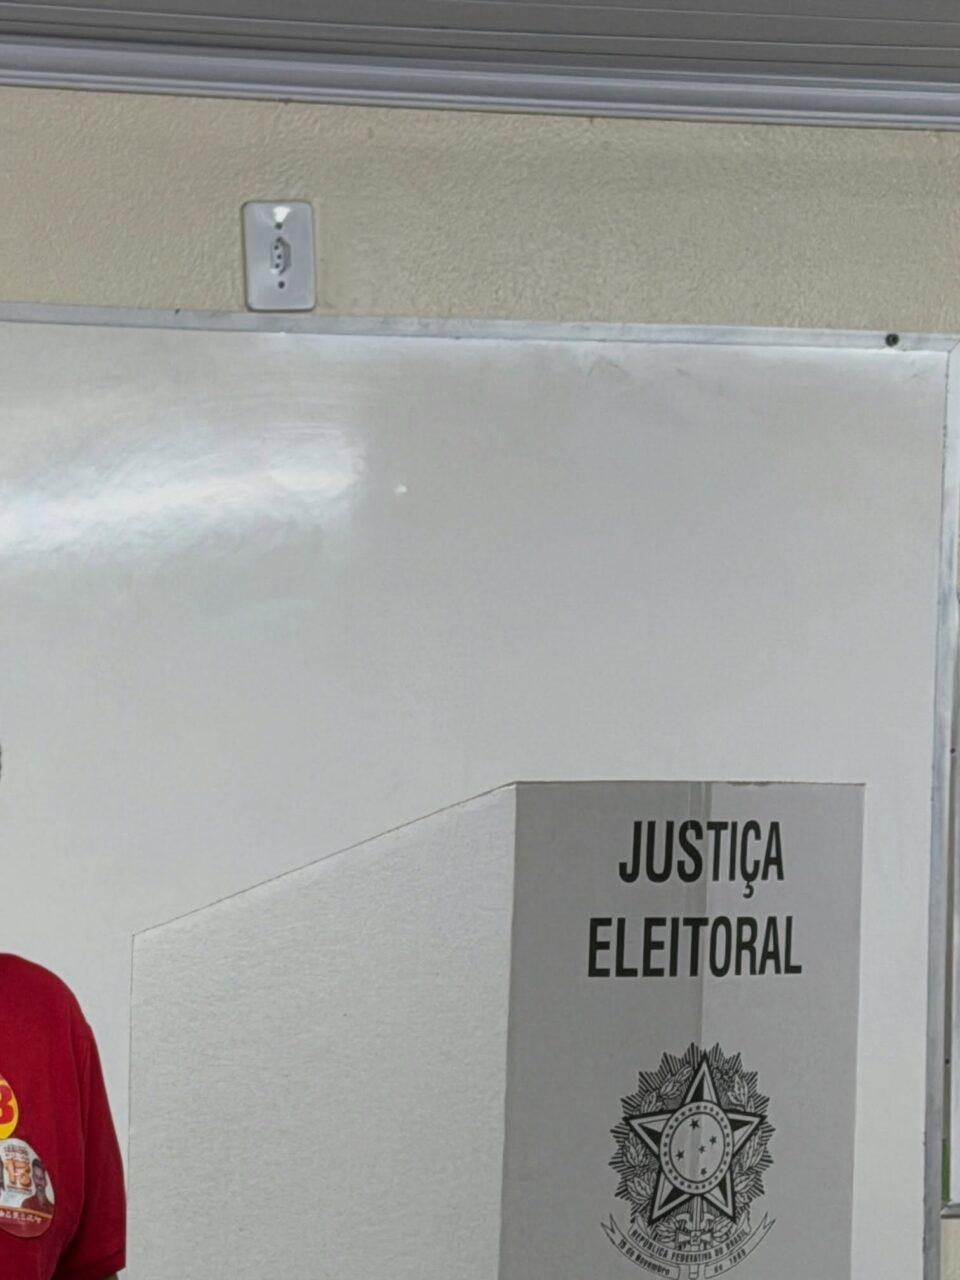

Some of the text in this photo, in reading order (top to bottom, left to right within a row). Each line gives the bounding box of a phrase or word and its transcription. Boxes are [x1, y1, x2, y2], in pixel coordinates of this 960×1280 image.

[619, 820, 785, 899] JUSTIÇA
[588, 916, 802, 977] ELEITORAL
[4, 1158, 33, 1188] 13
